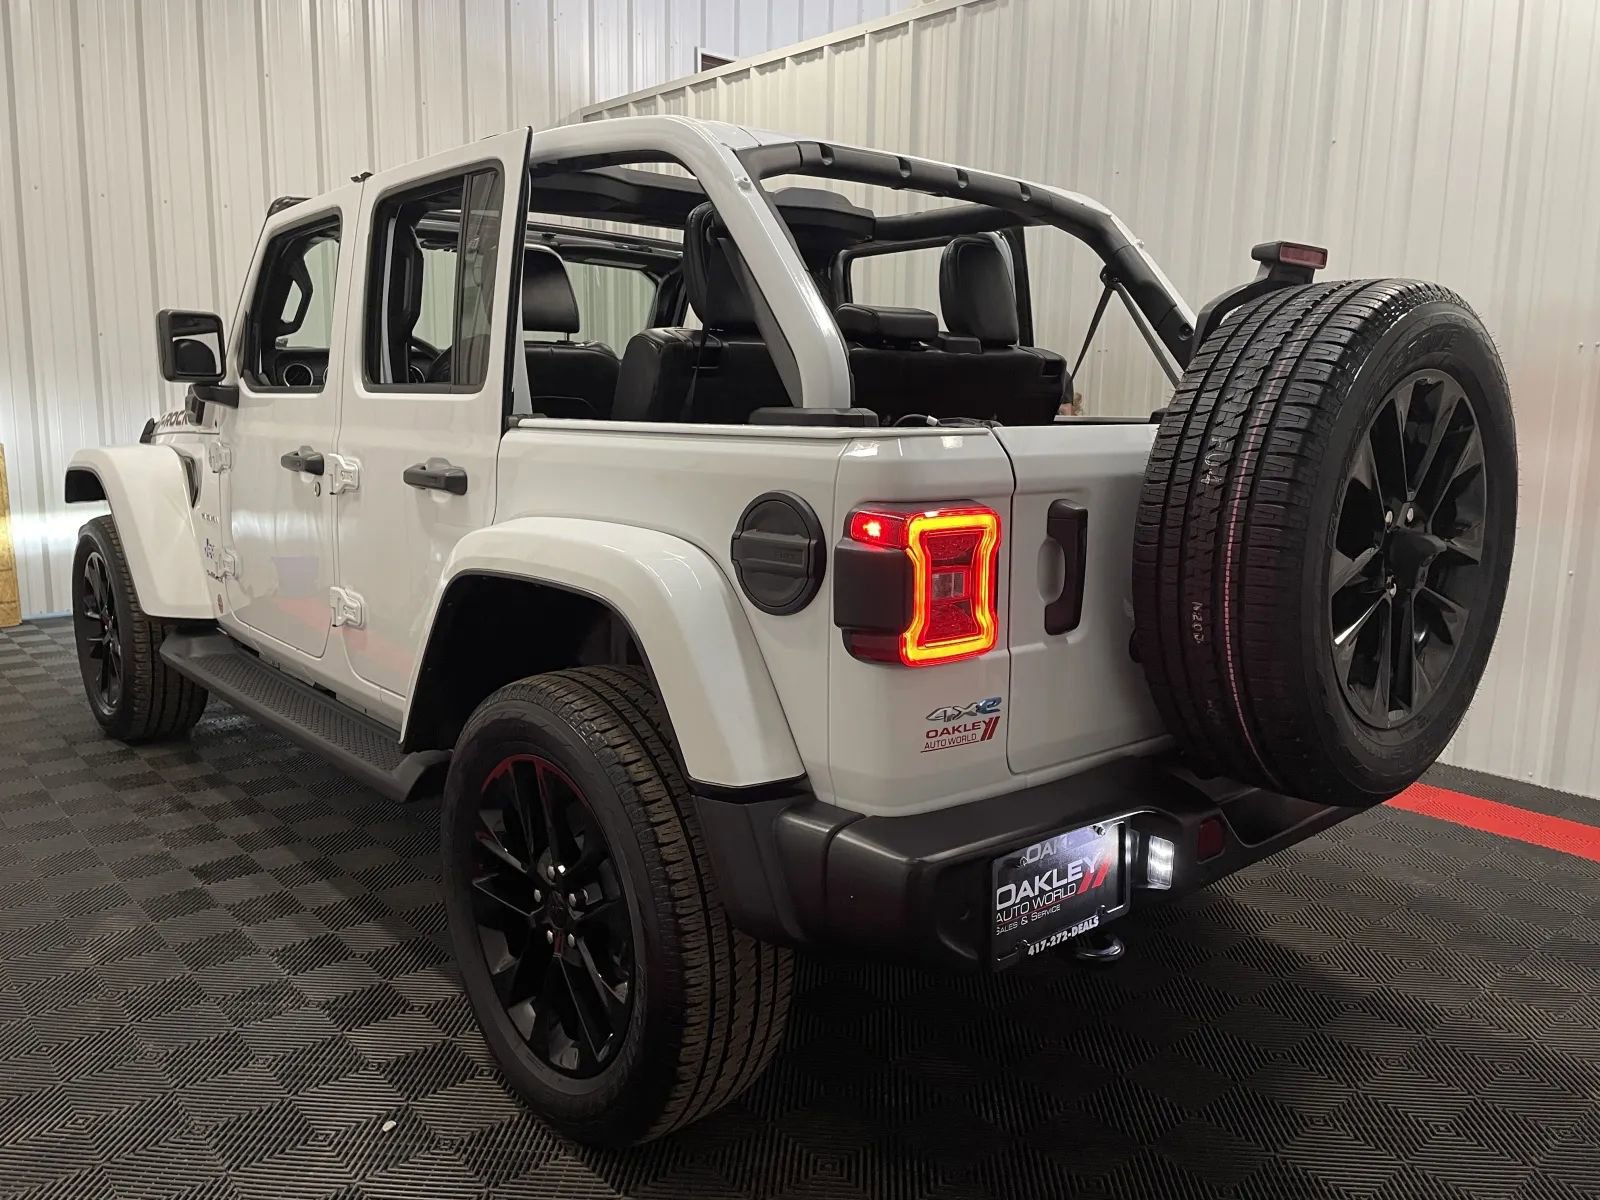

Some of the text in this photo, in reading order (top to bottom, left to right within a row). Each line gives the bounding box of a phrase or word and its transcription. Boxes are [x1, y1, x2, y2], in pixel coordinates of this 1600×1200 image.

[924, 733, 977, 749] AUTO WORLD
[925, 716, 997, 739] OAKLEY
[996, 851, 1102, 911] OAKLEY
[996, 883, 1077, 923] AUTO WORLD
[1027, 916, 1100, 956] 417-272-DEALS
